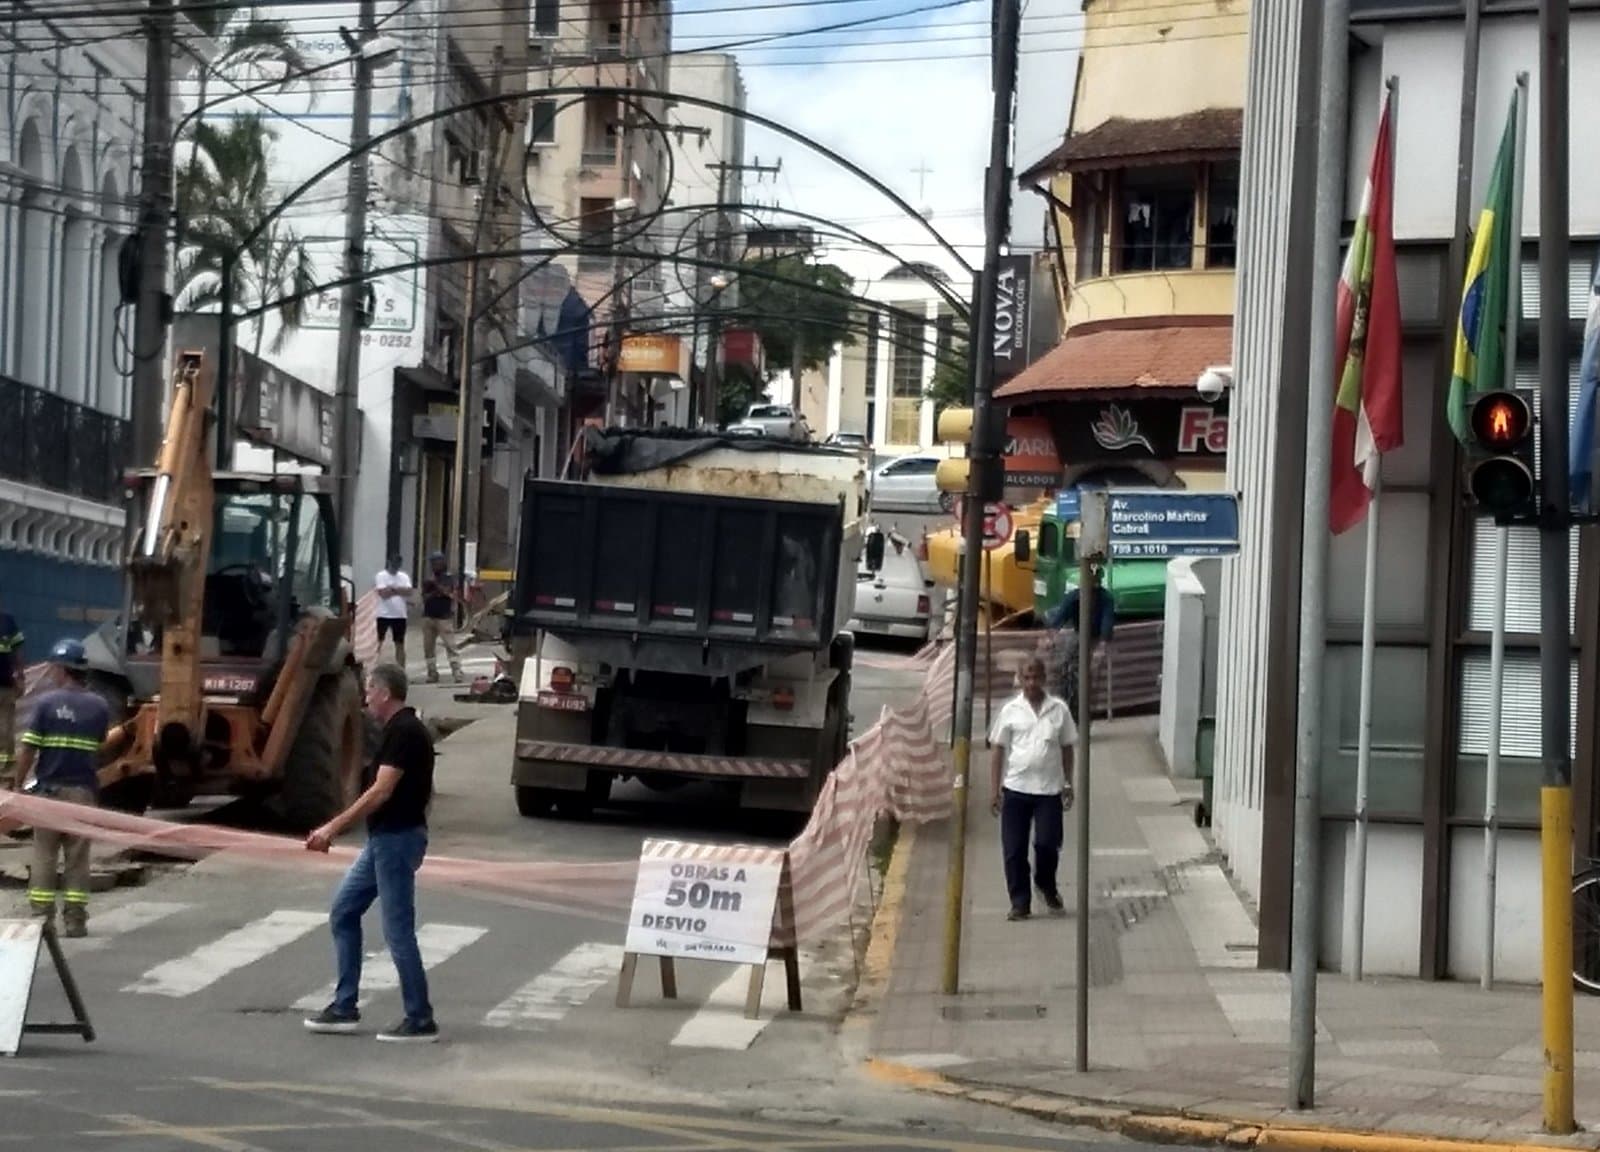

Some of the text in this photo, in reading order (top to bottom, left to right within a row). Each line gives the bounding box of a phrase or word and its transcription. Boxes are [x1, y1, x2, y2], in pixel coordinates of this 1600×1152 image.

[993, 266, 1015, 360] INOVA
[1005, 474, 1056, 486] ALÇADOS
[1112, 510, 1207, 522] Marcolino Martins
[1112, 523, 1149, 535] Cabral
[671, 863, 747, 883] OBRAS A
[664, 879, 743, 912] 50m
[642, 913, 707, 933] DESVIO
